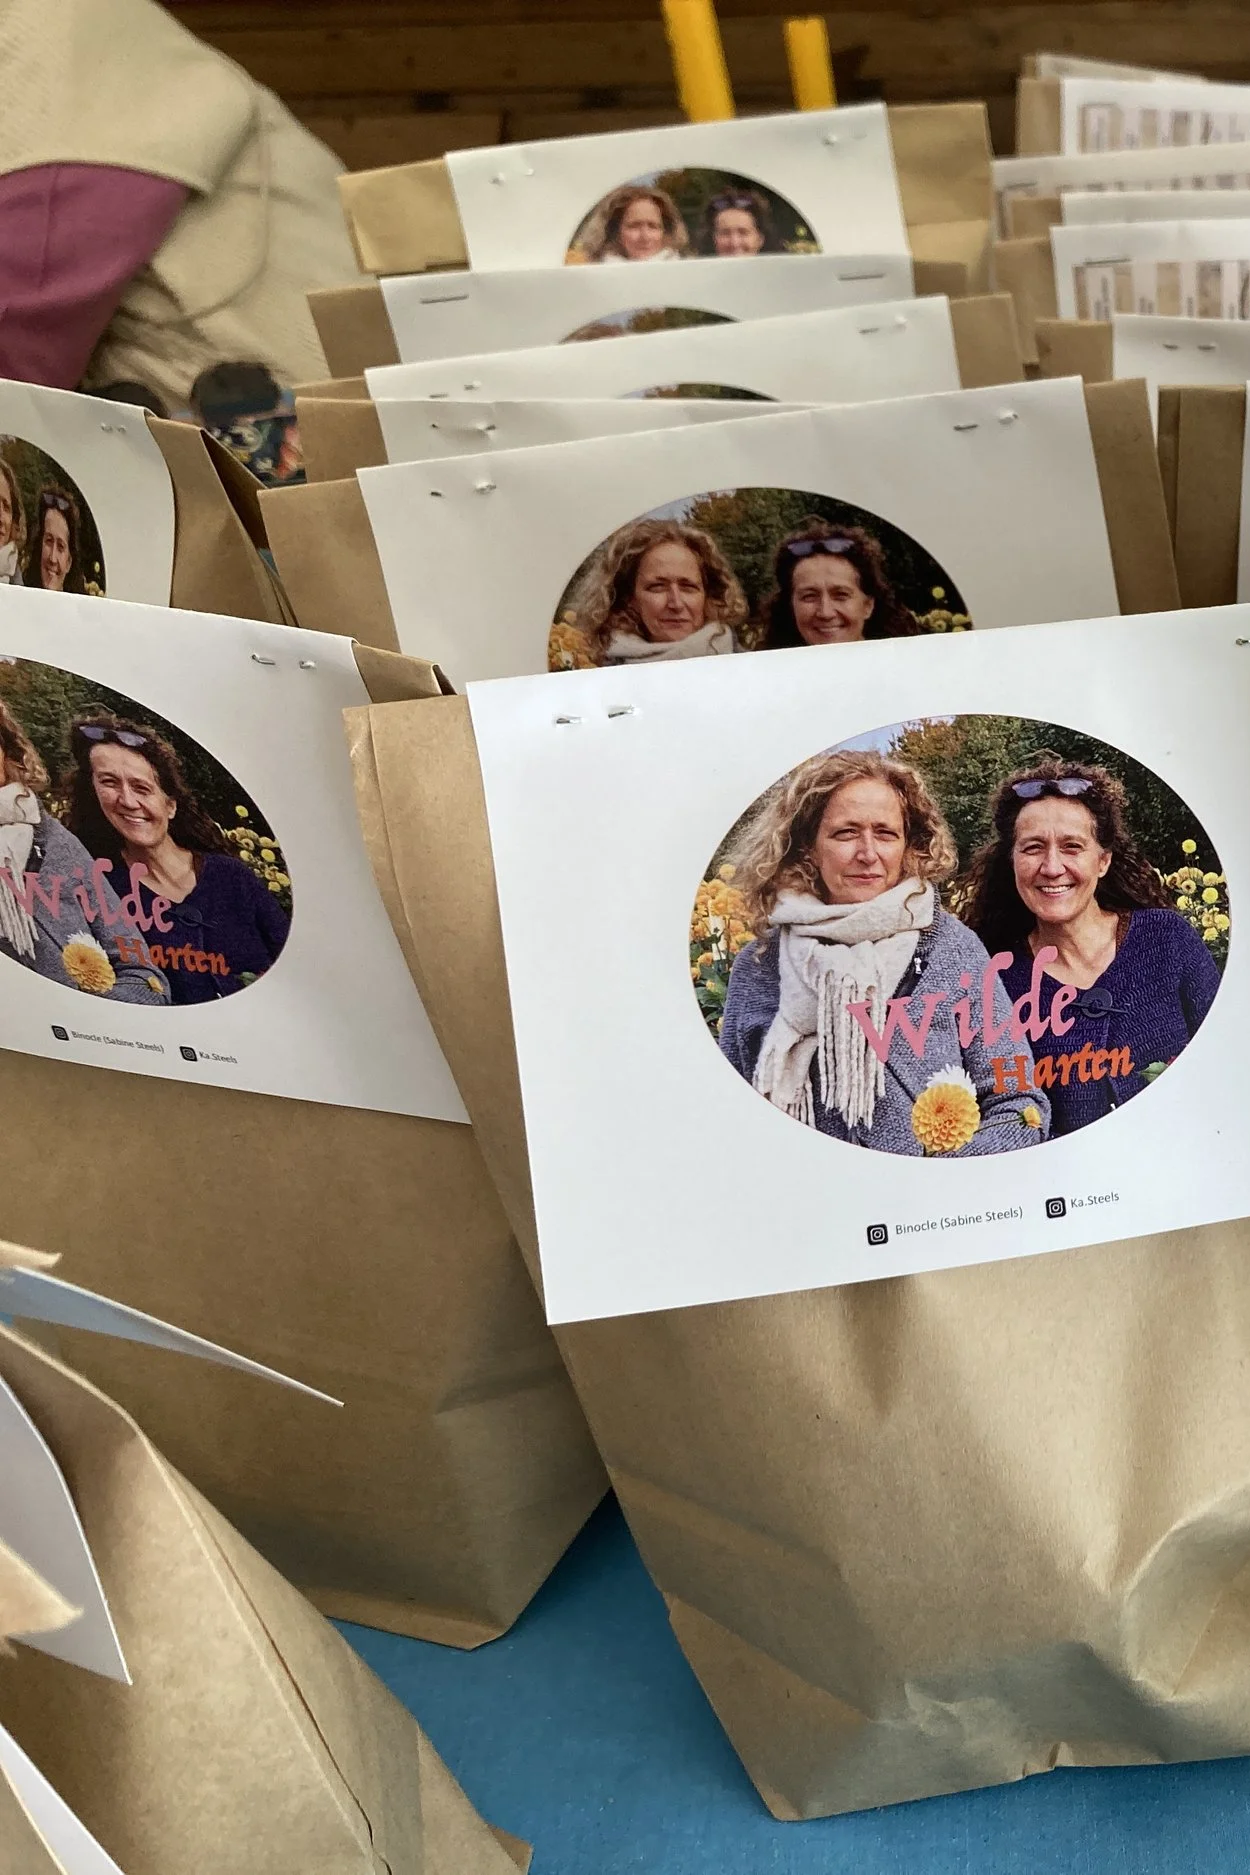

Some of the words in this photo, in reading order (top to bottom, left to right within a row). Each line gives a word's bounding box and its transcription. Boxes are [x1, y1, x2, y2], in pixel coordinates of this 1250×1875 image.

[0, 858, 173, 932] Wilde
[115, 935, 231, 975] Harten
[846, 946, 1077, 1063] Wilde
[990, 1041, 1134, 1094] Harten
[895, 1219, 937, 1235] Binocle
[940, 1213, 983, 1230] (Sabine
[985, 1206, 1024, 1222] Steels)
[1070, 1191, 1120, 1209] Ka.Steels
